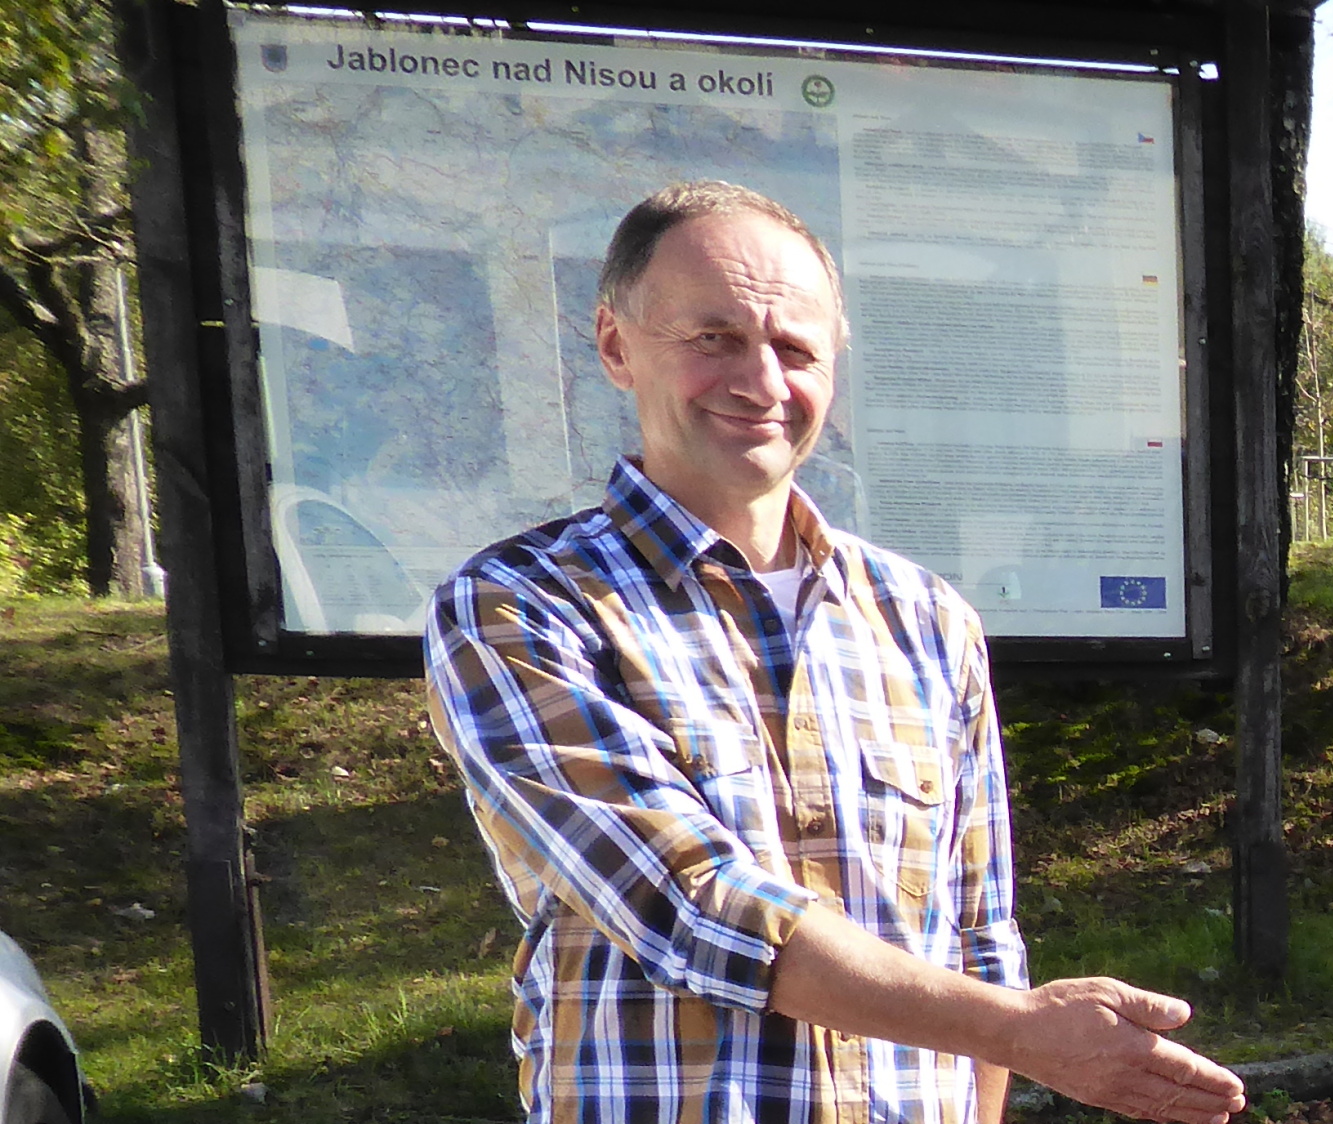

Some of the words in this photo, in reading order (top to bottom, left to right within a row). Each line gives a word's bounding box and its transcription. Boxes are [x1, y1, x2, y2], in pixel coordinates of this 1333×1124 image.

[327, 44, 479, 79] Jablonec
[492, 58, 552, 83] nad
[564, 59, 657, 90] Nisou
[669, 72, 687, 92] a
